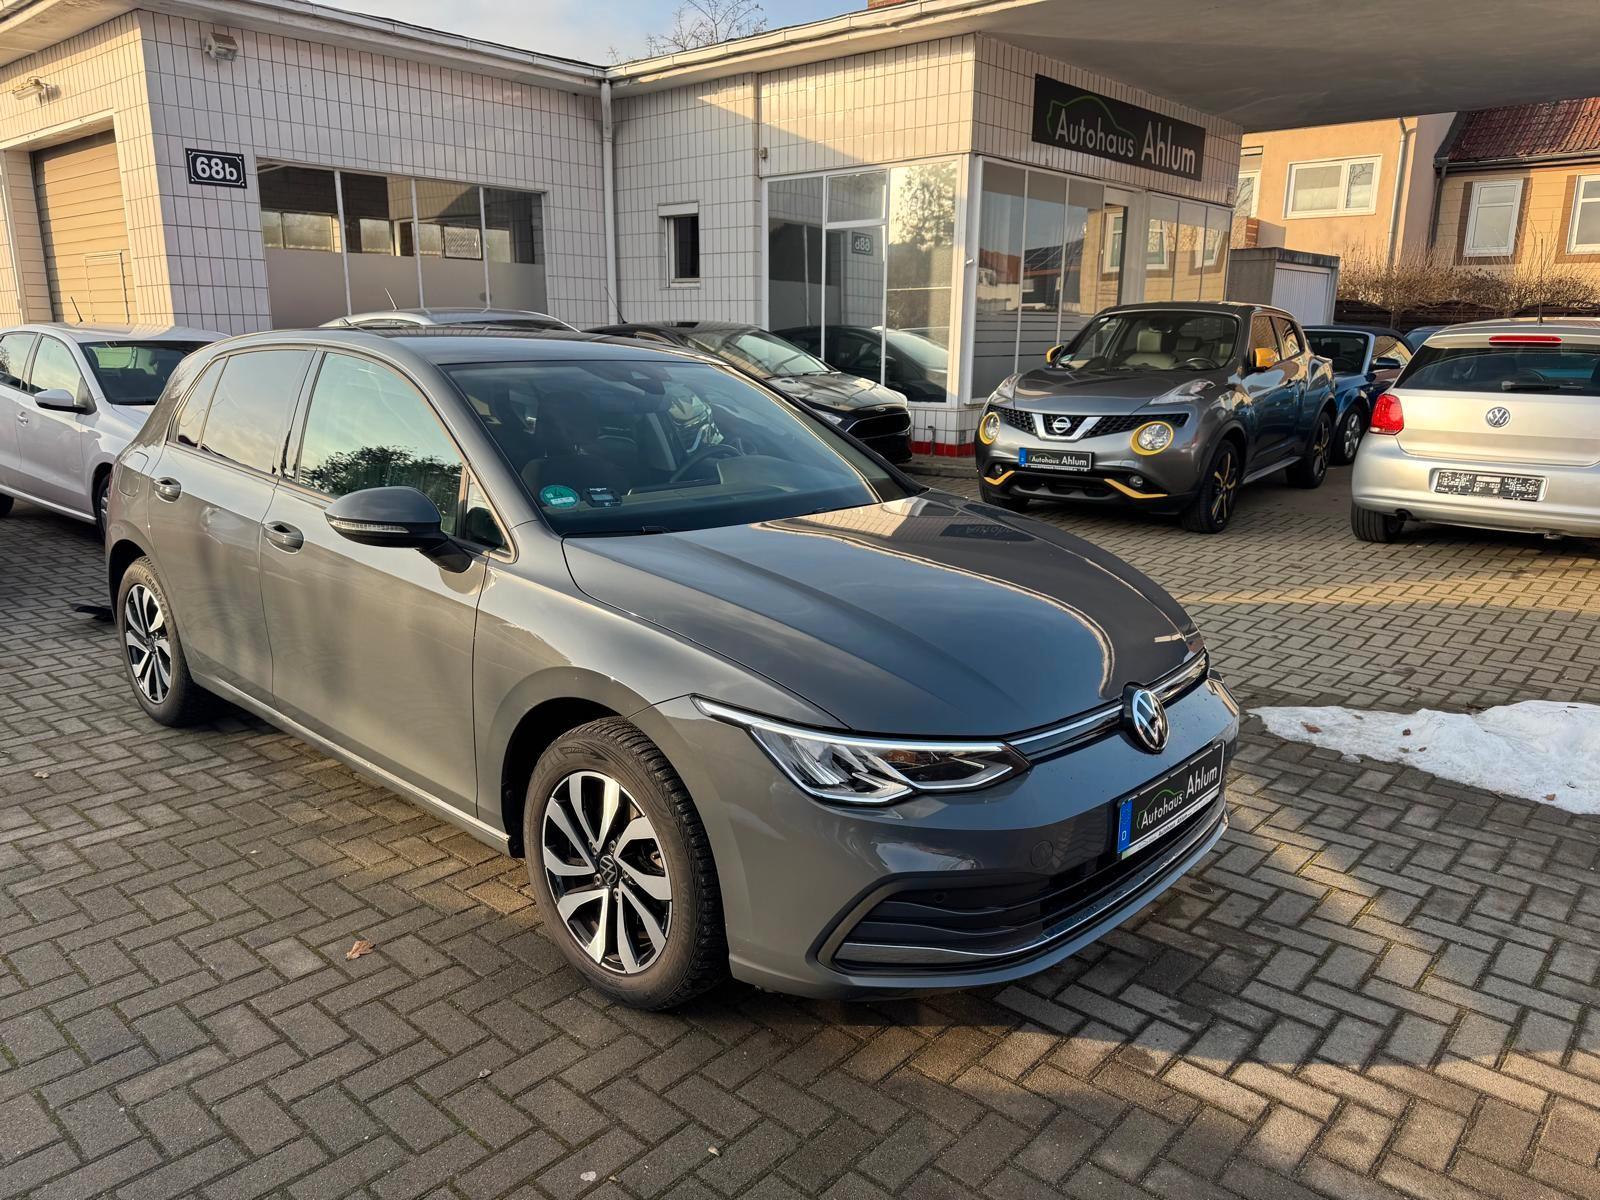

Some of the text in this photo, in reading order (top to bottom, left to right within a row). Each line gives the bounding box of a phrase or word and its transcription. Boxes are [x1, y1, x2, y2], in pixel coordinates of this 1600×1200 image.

[1055, 107, 1196, 174] Autohaus Ahlum
[195, 156, 238, 181] 68b
[1031, 456, 1060, 464] Autohaus
[1061, 455, 1087, 466] Ahlum
[1140, 793, 1183, 830] Autohaus
[1185, 766, 1218, 799] Ahlum
